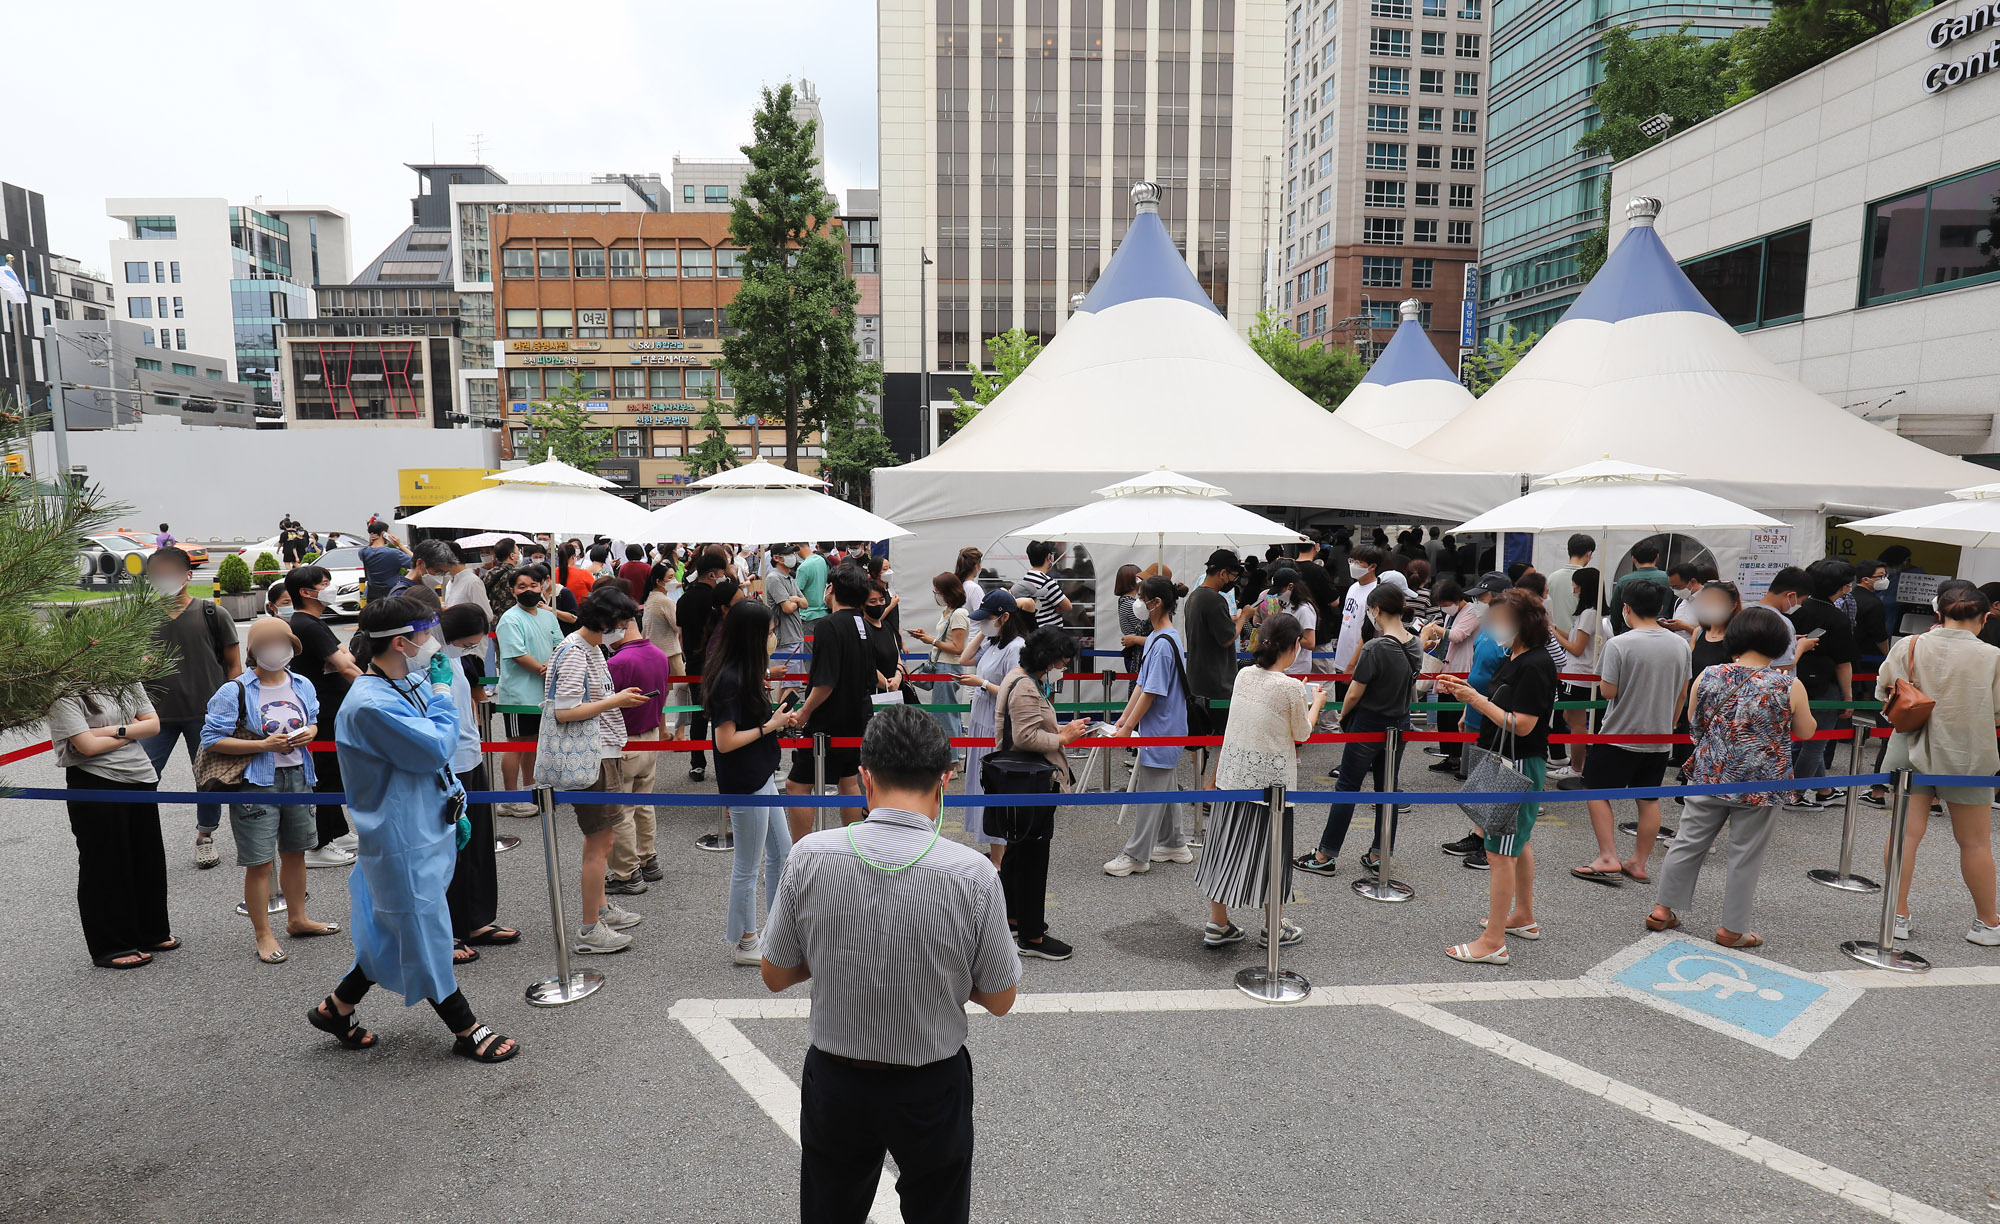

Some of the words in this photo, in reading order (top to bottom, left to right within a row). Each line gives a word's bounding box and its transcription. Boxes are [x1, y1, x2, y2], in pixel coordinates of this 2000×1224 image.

[583, 312, 606, 325] 여권
[636, 416, 653, 425] 신한
[655, 416, 689, 425] 노무법인
[1754, 534, 1787, 544] 대화금지
